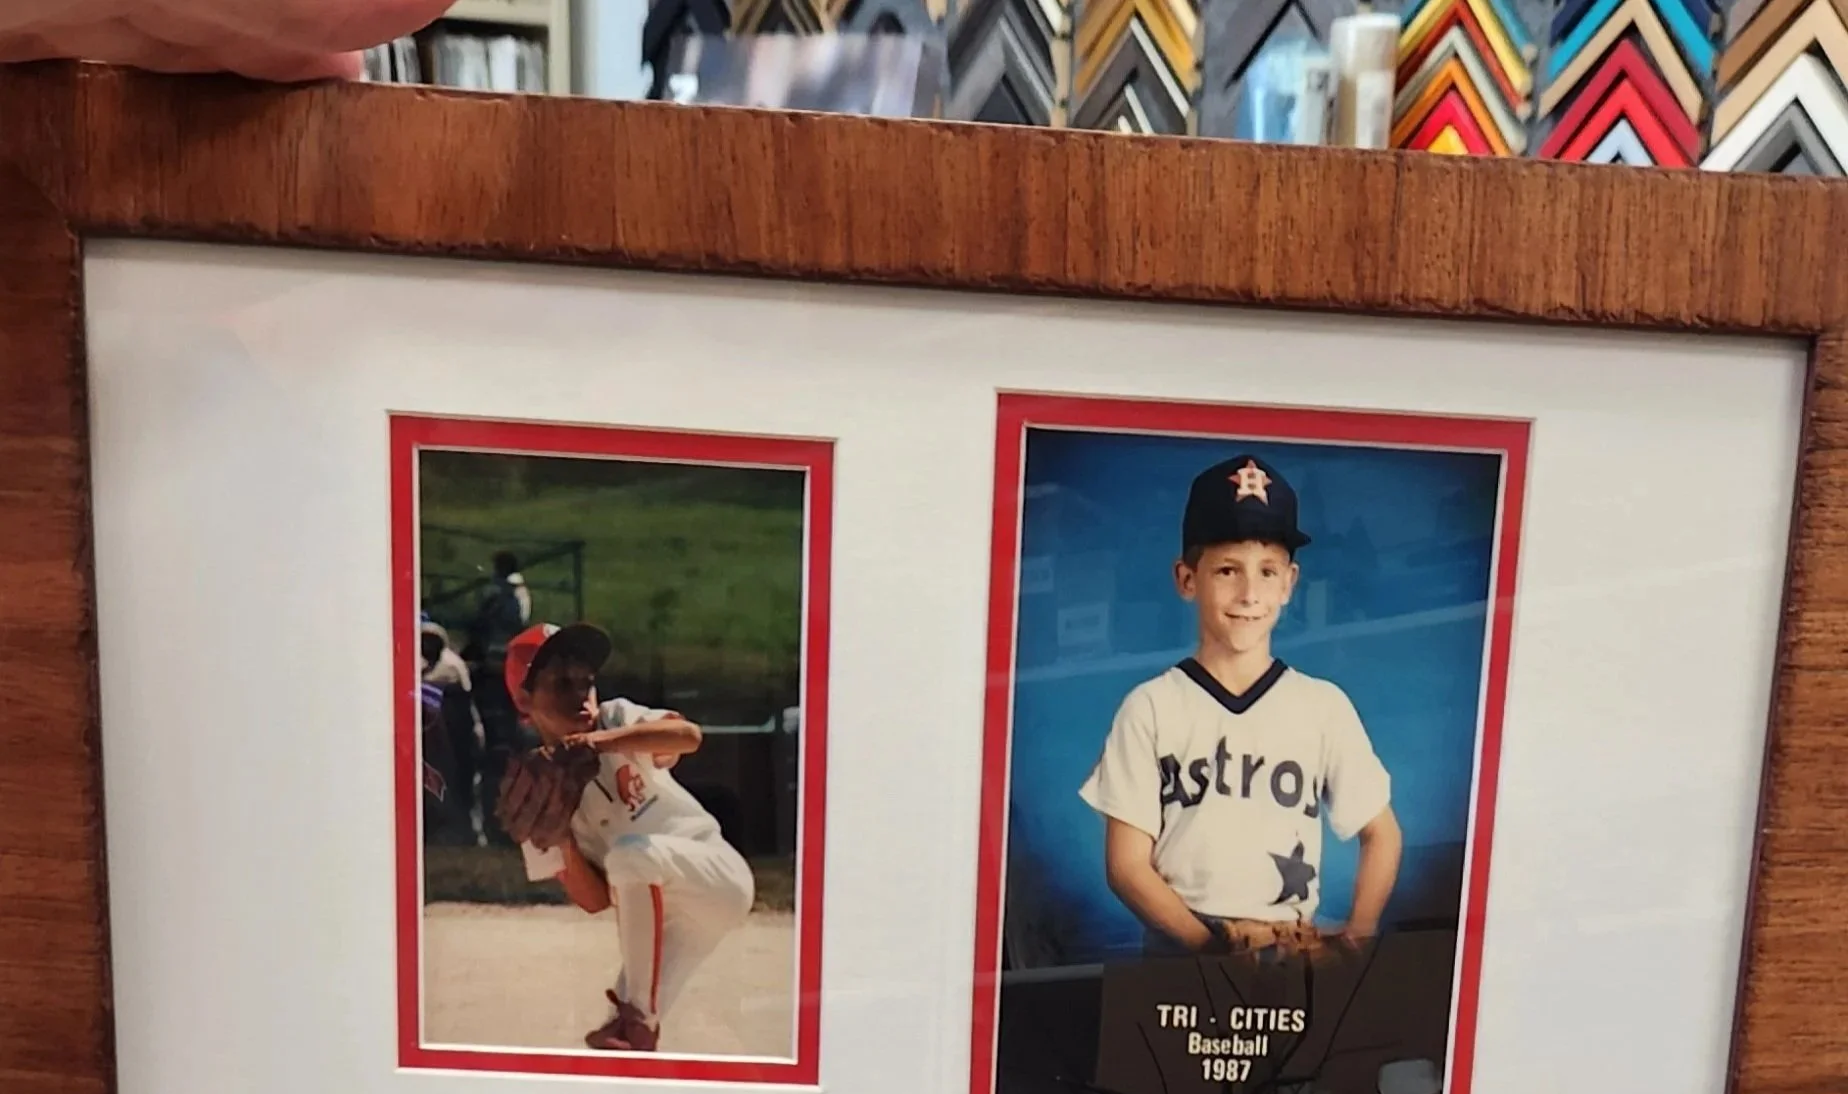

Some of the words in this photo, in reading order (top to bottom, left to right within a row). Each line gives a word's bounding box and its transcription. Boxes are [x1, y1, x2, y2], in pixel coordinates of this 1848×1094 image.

[1156, 1004, 1198, 1028] TRI
[1230, 1007, 1306, 1032] CITIES
[1188, 1032, 1268, 1056] Baseball
[1202, 1058, 1251, 1082] 1987
